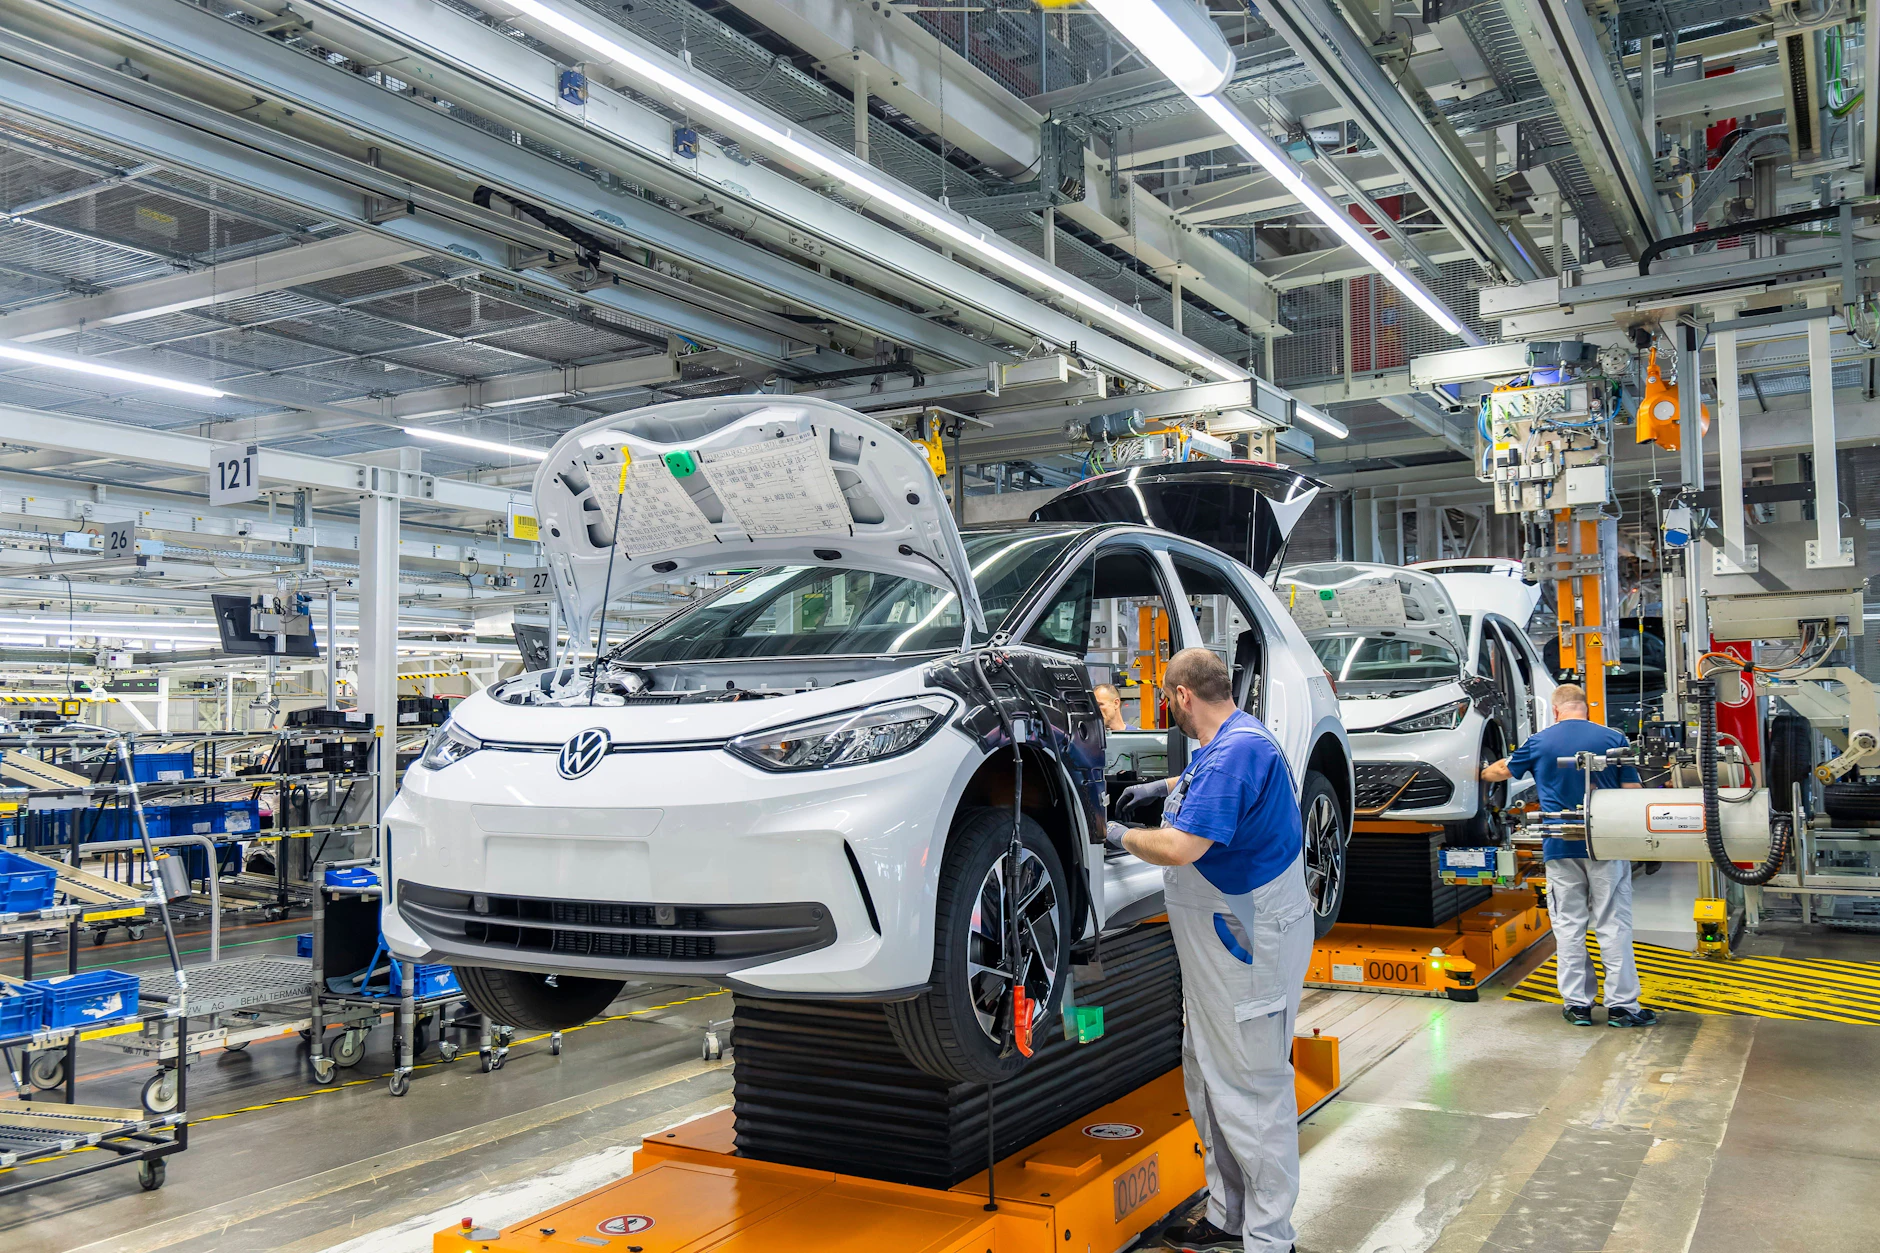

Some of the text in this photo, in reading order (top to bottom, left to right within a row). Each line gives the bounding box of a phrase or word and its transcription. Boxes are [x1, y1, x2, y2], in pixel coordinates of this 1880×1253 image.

[217, 457, 251, 491] 121
[110, 530, 127, 549] 26
[533, 573, 548, 588] 27
[1095, 625, 1107, 634] 30
[556, 729, 608, 780] VW
[1368, 961, 1419, 983] 0001
[211, 1001, 225, 1011] AG
[1117, 1160, 1157, 1215] 0026
